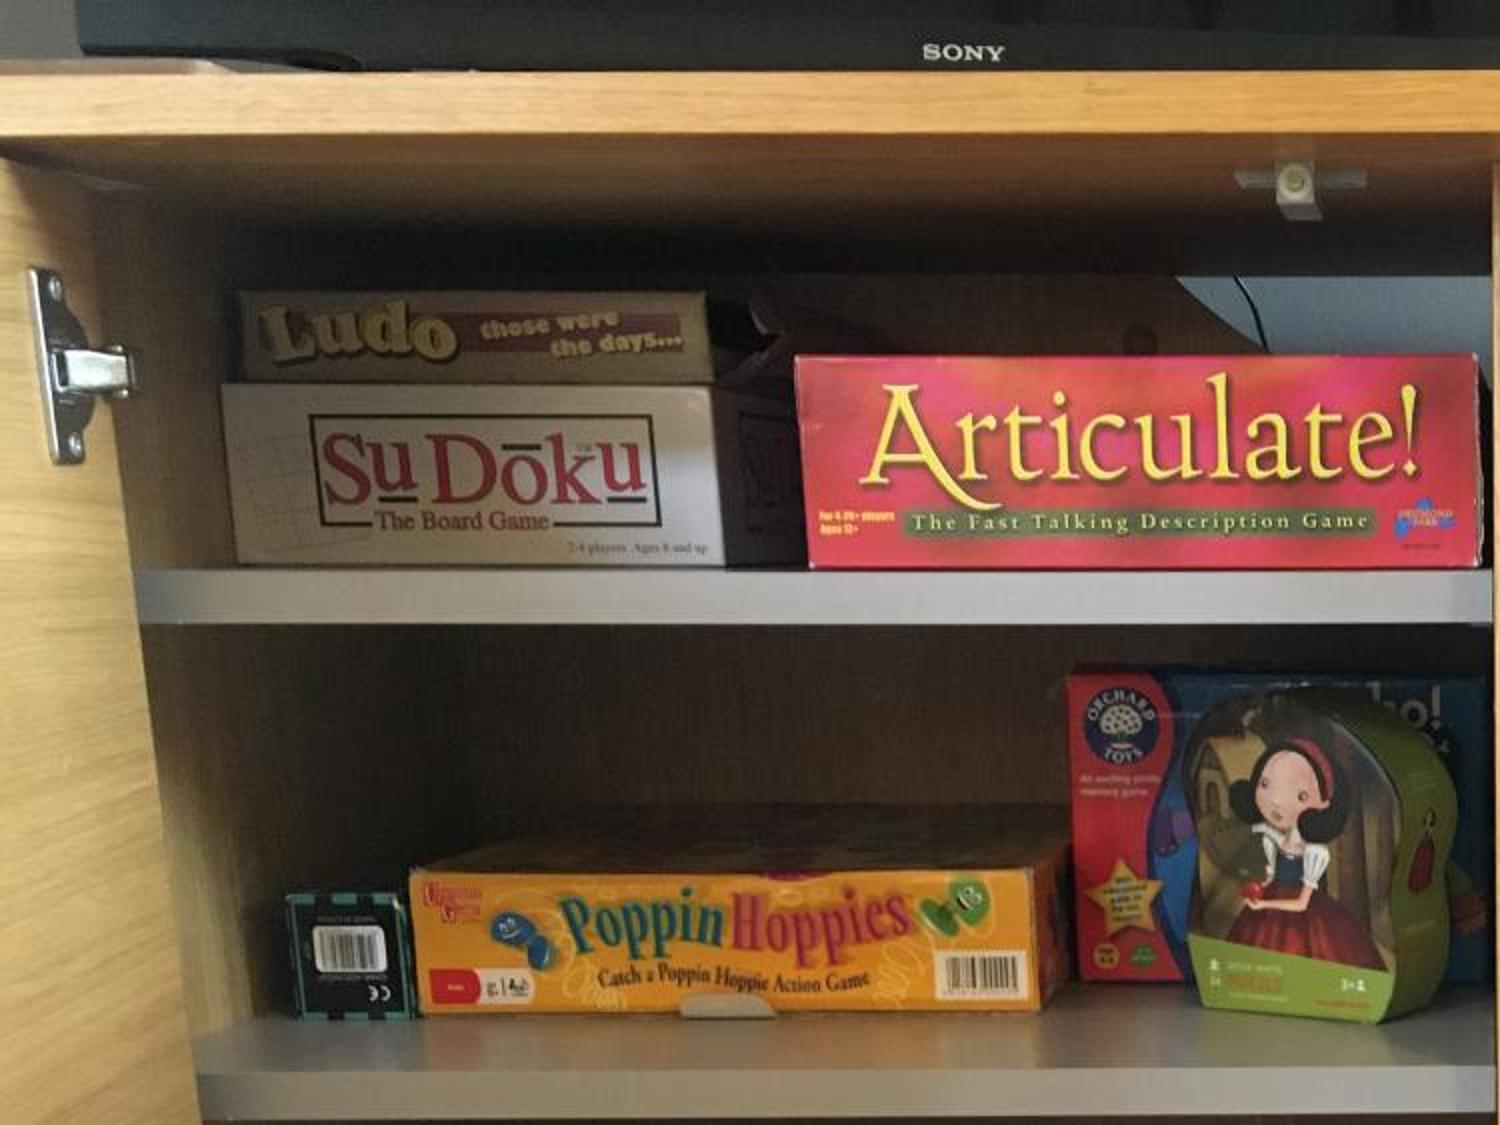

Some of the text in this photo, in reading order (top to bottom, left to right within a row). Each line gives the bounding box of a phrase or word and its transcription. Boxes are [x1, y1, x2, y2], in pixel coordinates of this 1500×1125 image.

[922, 43, 1005, 62] SONY
[258, 299, 459, 361] Ludo
[480, 311, 619, 340] those were
[552, 338, 592, 356] the
[859, 371, 1418, 511] Articulate!
[375, 511, 549, 530] The Board Game
[912, 512, 1369, 536] The Fast Talking Description Game
[1087, 688, 1156, 721] ORCHARD
[1104, 747, 1145, 763] TOYS
[555, 886, 724, 960] Poppin
[731, 885, 914, 970] Hoppies
[598, 965, 642, 988] Catch
[656, 963, 711, 988] Poppin
[715, 965, 769, 991] Hoppie
[772, 974, 822, 993] Action
[825, 970, 871, 992] Game
